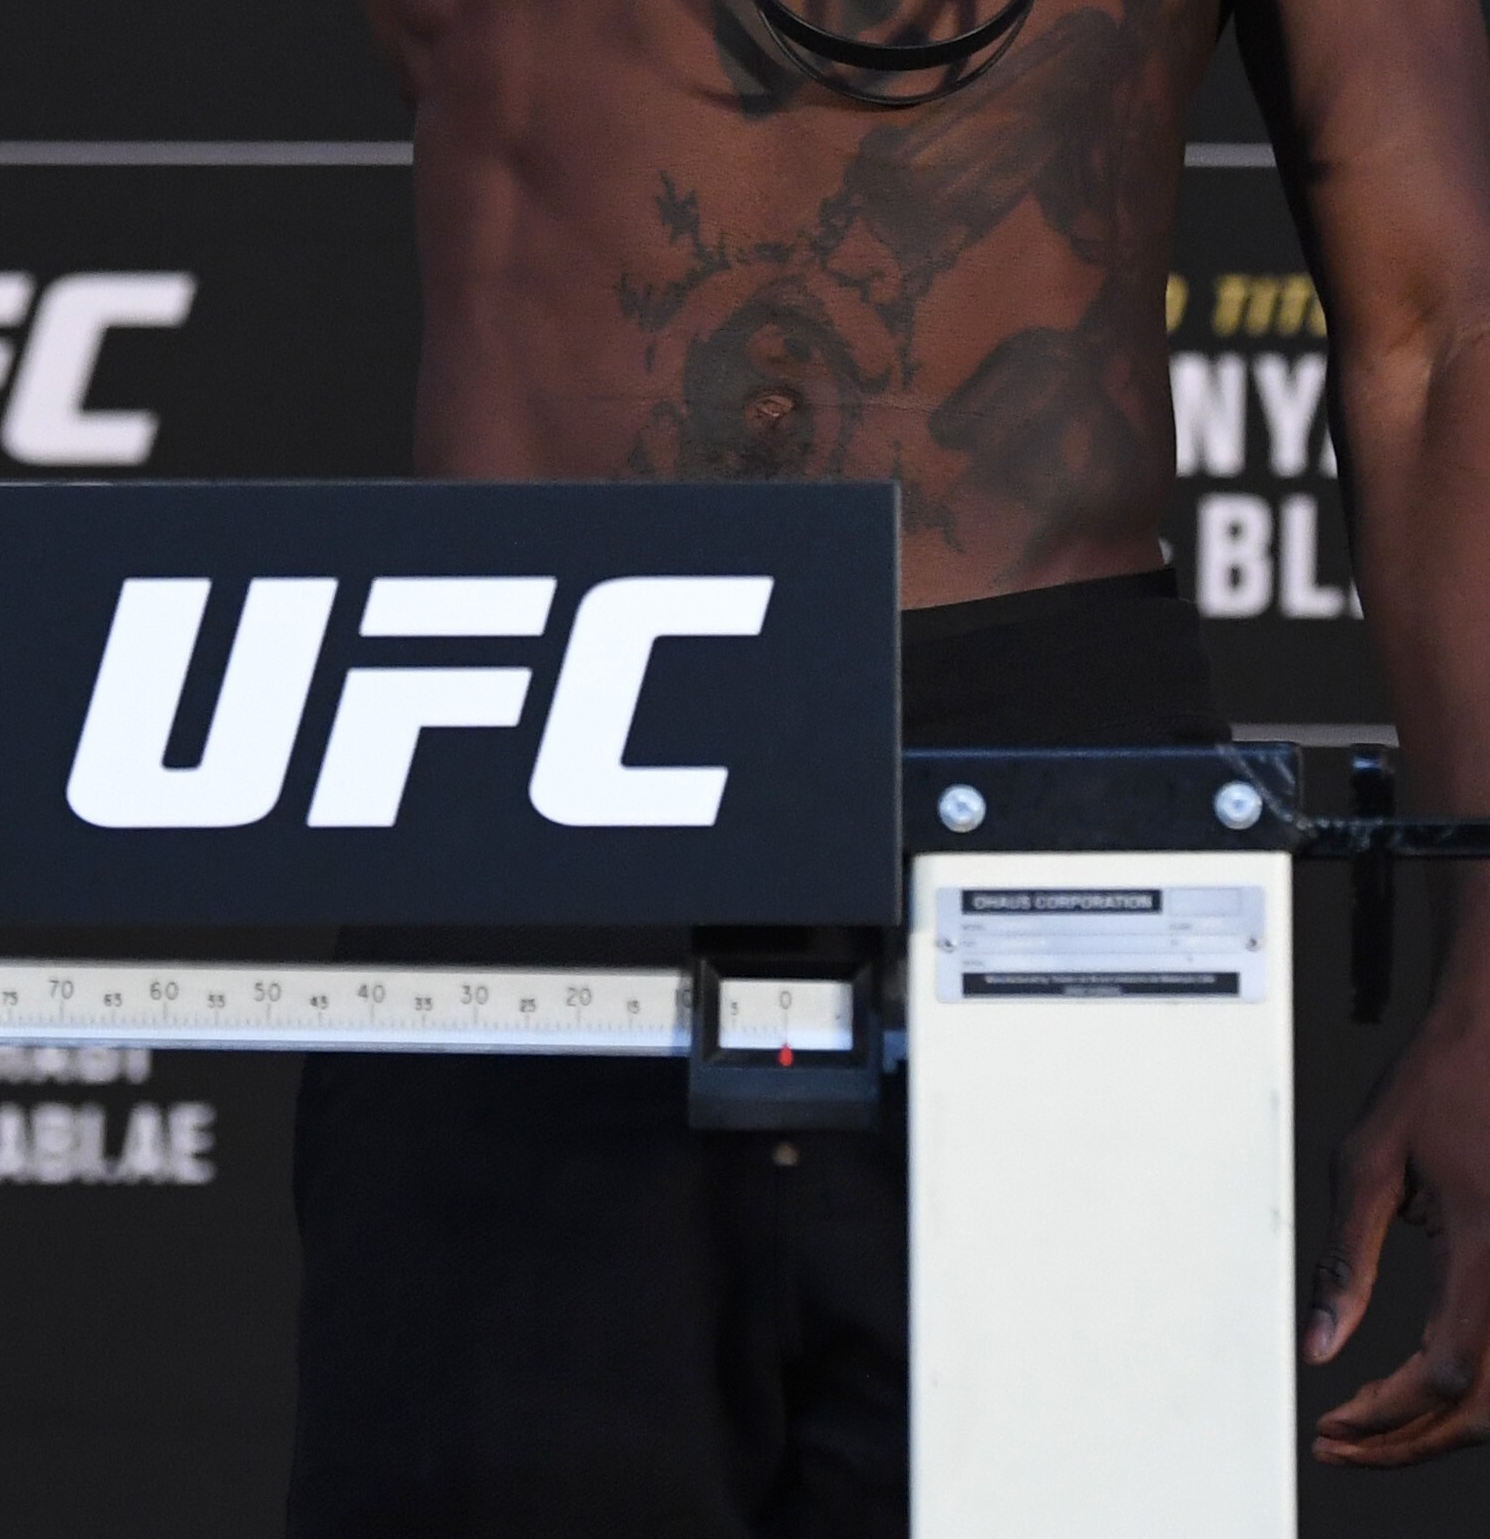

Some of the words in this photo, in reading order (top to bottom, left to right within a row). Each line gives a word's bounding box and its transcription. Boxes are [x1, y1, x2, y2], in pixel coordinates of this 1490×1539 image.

[66, 575, 774, 829] UFC
[1033, 894, 1154, 910] CORPORATION
[49, 978, 75, 1000] 70
[149, 980, 179, 1001] 60
[254, 981, 282, 1002] 50
[357, 983, 385, 1003] 40
[462, 984, 489, 1005] 30
[565, 985, 593, 1007] 20
[778, 989, 793, 1011] 0
